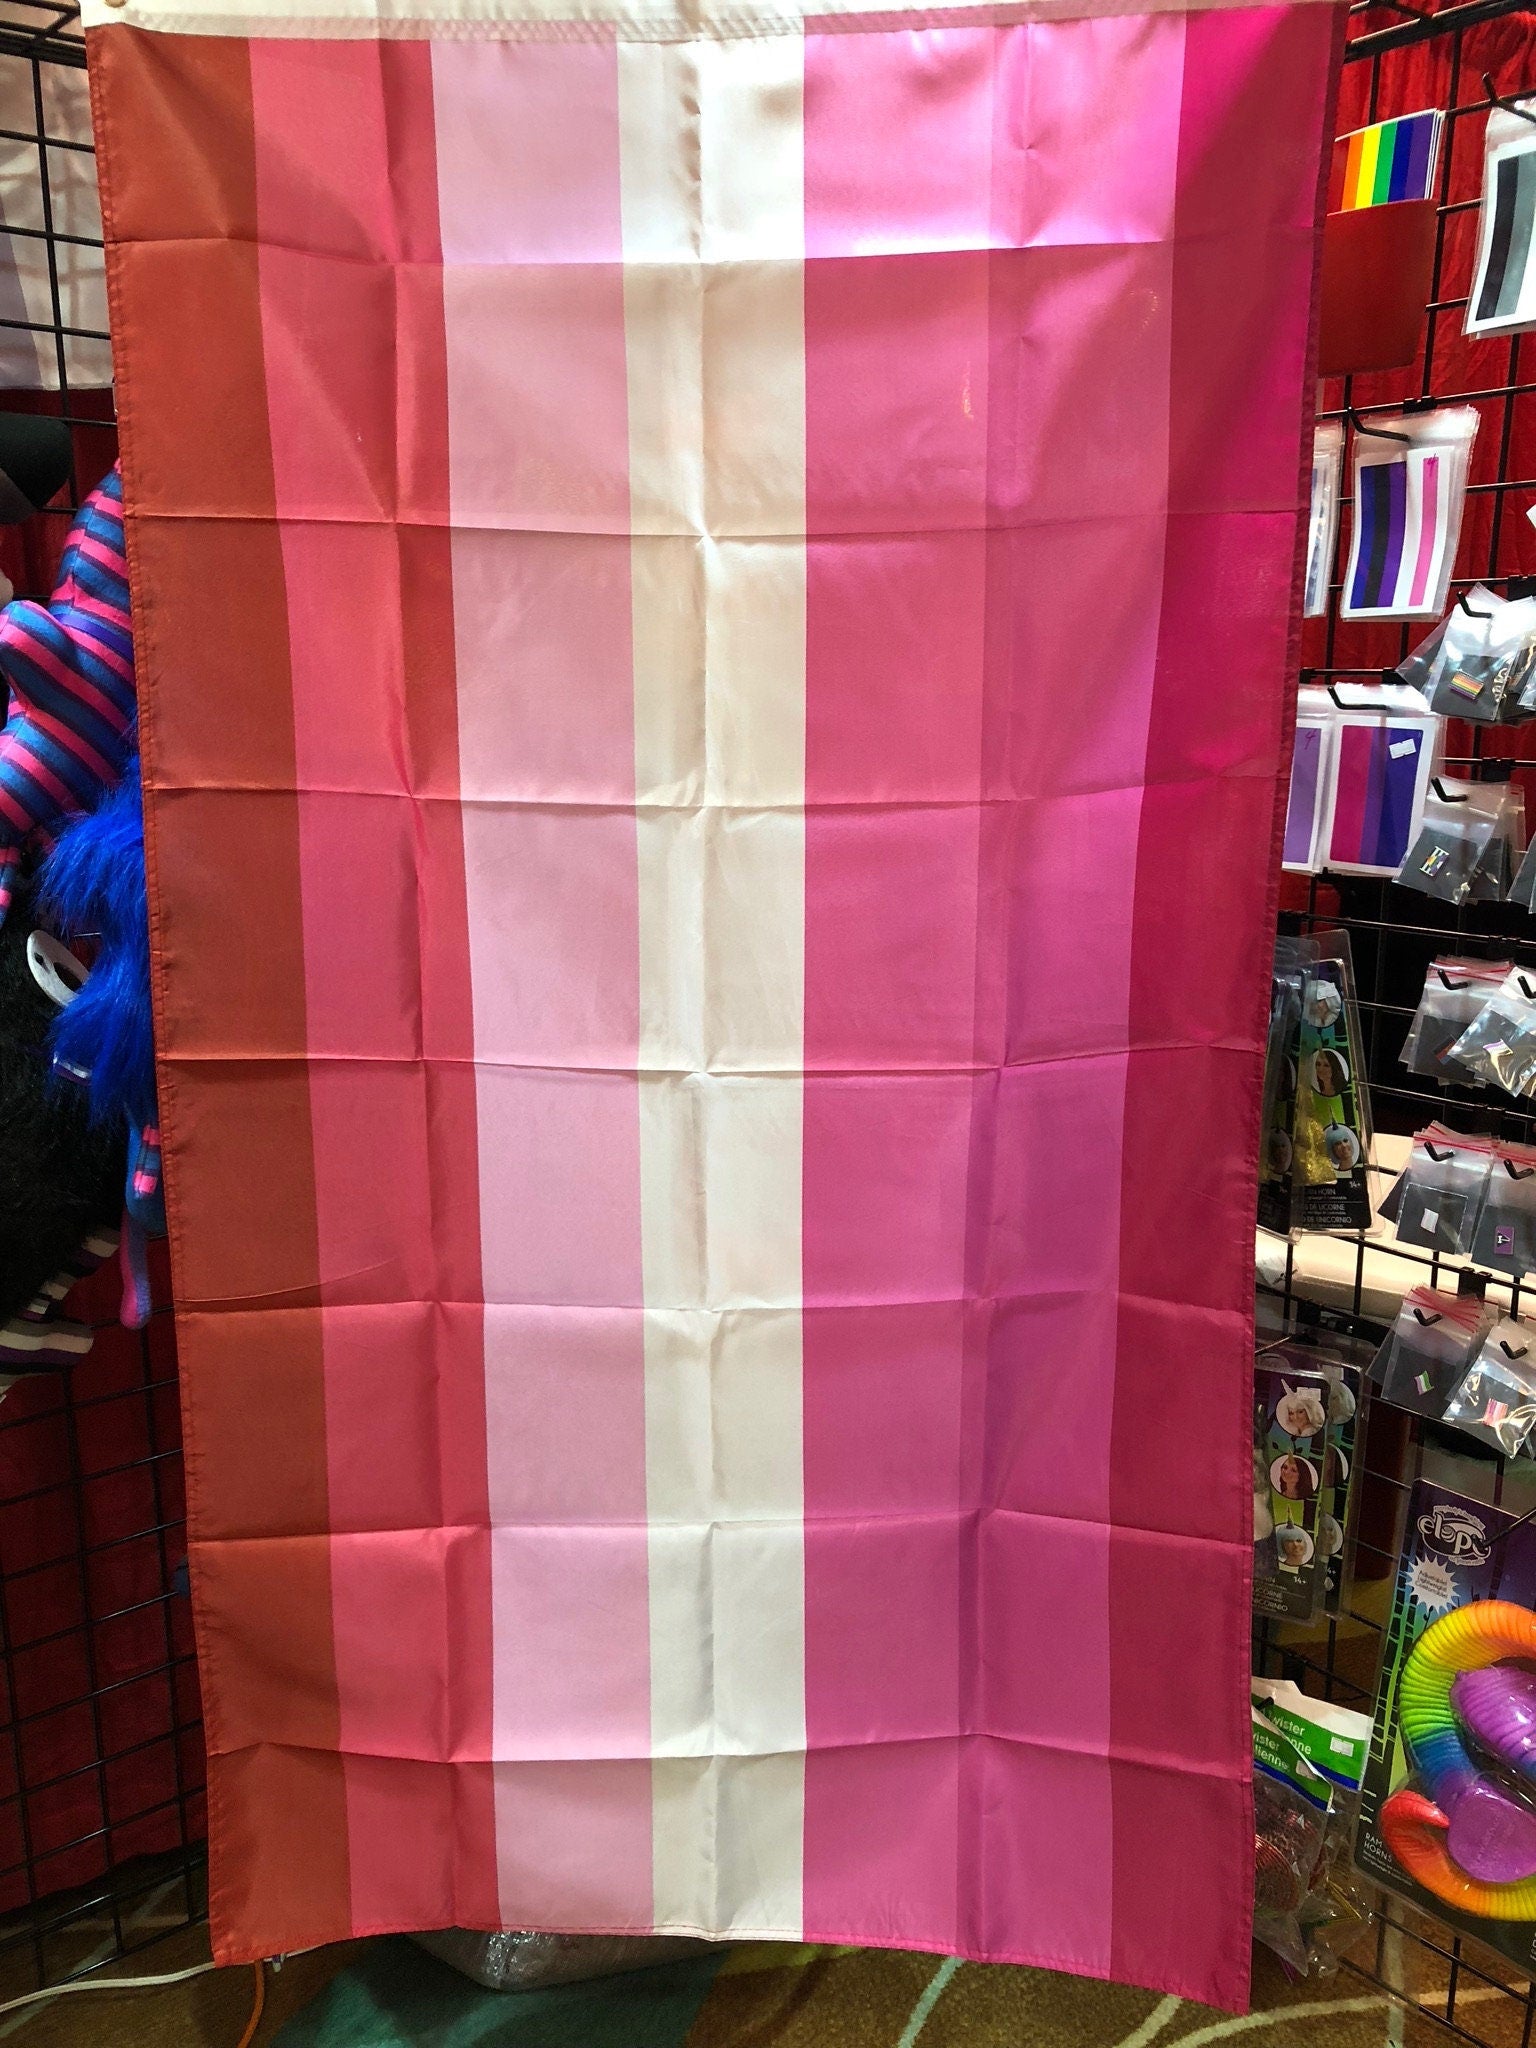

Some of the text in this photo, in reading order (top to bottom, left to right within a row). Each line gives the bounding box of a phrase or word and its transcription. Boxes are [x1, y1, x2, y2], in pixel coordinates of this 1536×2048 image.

[1253, 1731, 1281, 1752] ister
[1365, 1832, 1383, 1848] RAM
[1364, 1840, 1393, 1863] HORNS
